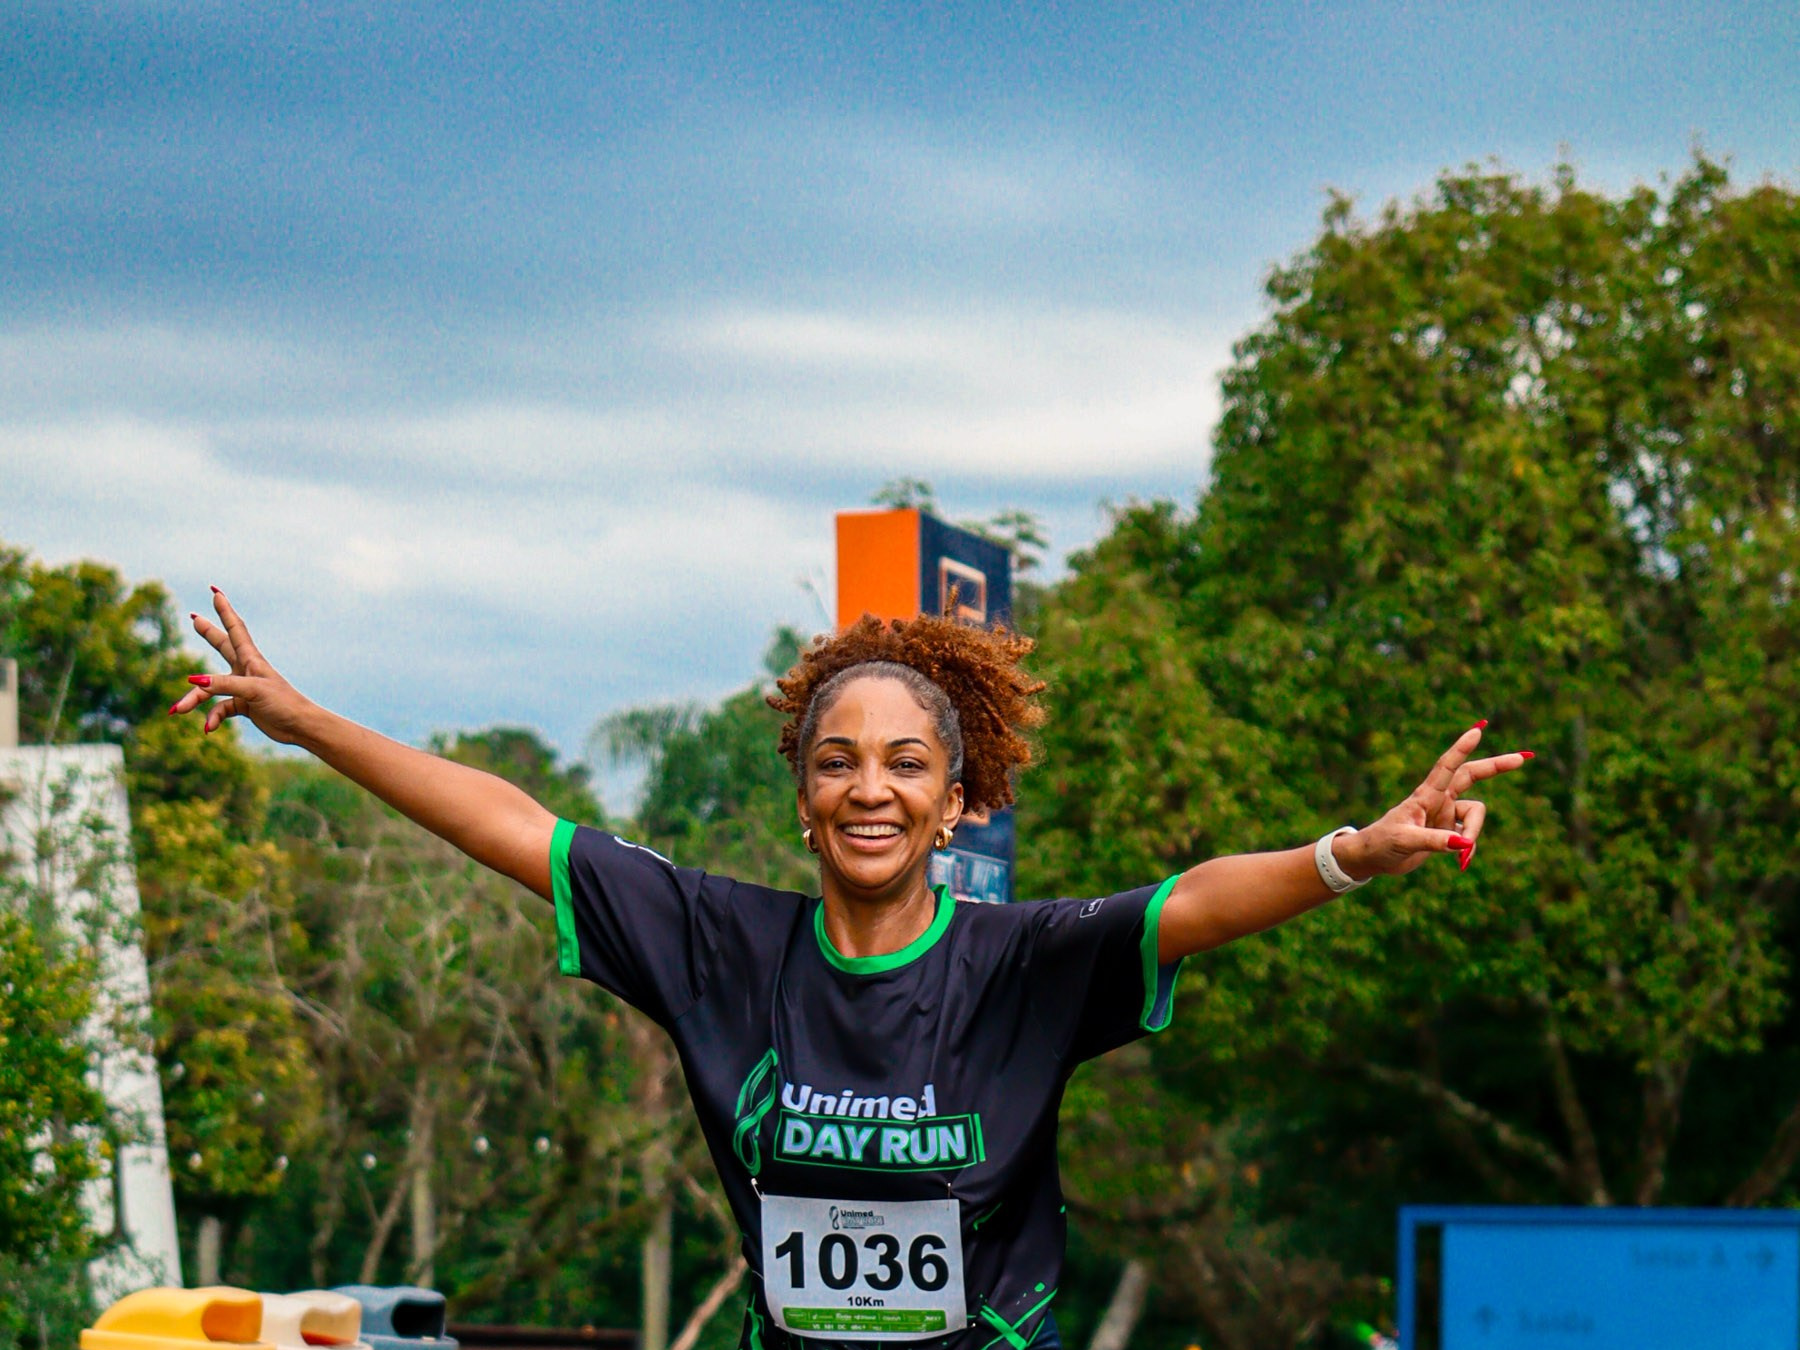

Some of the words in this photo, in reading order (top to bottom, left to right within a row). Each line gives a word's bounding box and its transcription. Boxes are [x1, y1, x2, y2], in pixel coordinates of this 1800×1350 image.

[781, 1081, 937, 1121] Unimed
[782, 1118, 878, 1162] DAY
[880, 1123, 968, 1165] RUN
[840, 1209, 874, 1217] Unimed
[775, 1231, 950, 1292] 1036
[847, 1296, 885, 1307] 10Km
